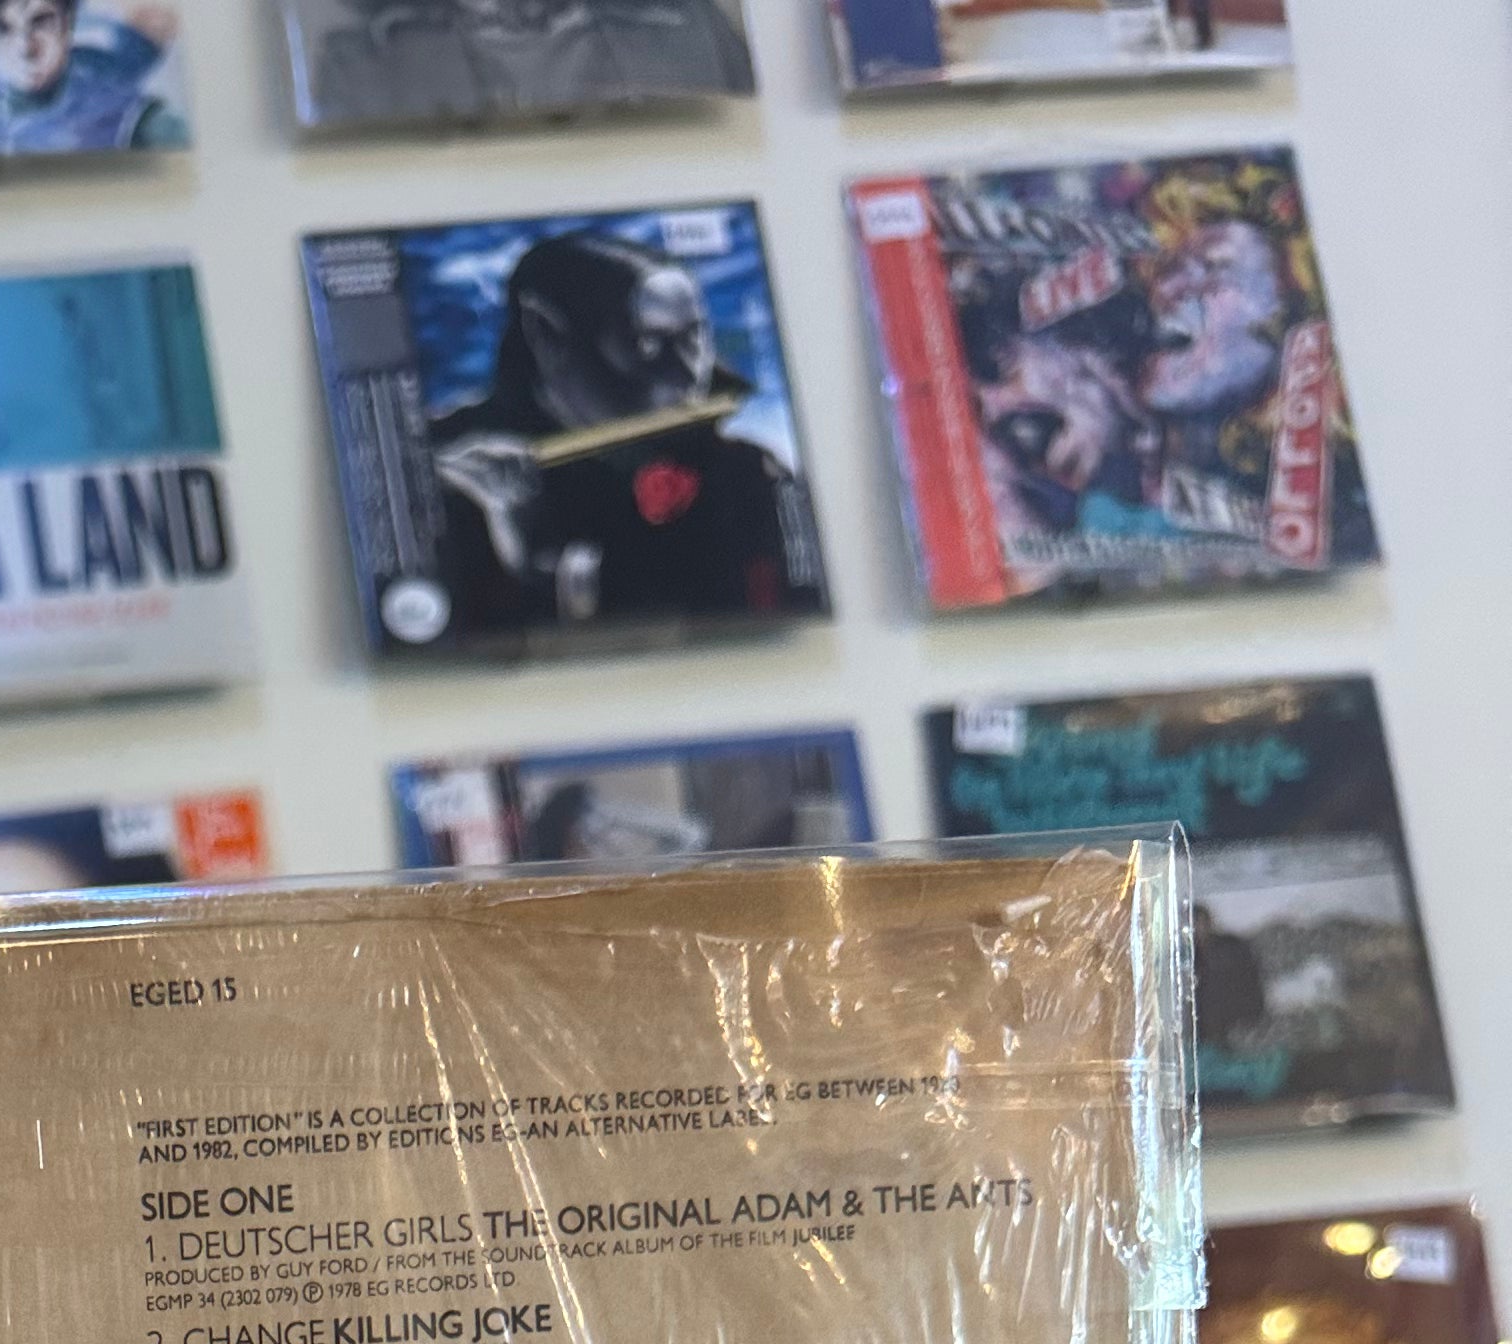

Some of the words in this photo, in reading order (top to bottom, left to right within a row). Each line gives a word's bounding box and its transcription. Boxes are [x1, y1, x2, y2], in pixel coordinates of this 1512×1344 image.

[22, 465, 234, 596] LAND
[129, 978, 205, 1008] EGED
[211, 975, 239, 1002] 15
[307, 1110, 323, 1129] IS
[329, 1108, 344, 1128] A
[492, 1098, 522, 1119] OF
[526, 1093, 609, 1117] TRACKS
[817, 1076, 915, 1101] BETWEEN
[137, 1142, 188, 1164] AND
[193, 1139, 238, 1161] 1982,
[243, 1132, 350, 1158] COMPILED
[357, 1130, 382, 1151] BY
[564, 1111, 702, 1138] ALTERNATIVE
[140, 1190, 210, 1222] SIDE
[219, 1185, 292, 1217] ONE
[143, 1234, 166, 1264] 1.
[179, 1221, 374, 1261] DEUTSCHER
[383, 1214, 473, 1248] GIRLS
[483, 1209, 548, 1241] THE
[557, 1198, 721, 1237] ORIGINAL
[730, 1191, 832, 1225] ADAM
[841, 1189, 864, 1218] &
[872, 1184, 936, 1216] THE
[474, 1304, 554, 1341] JOKE
